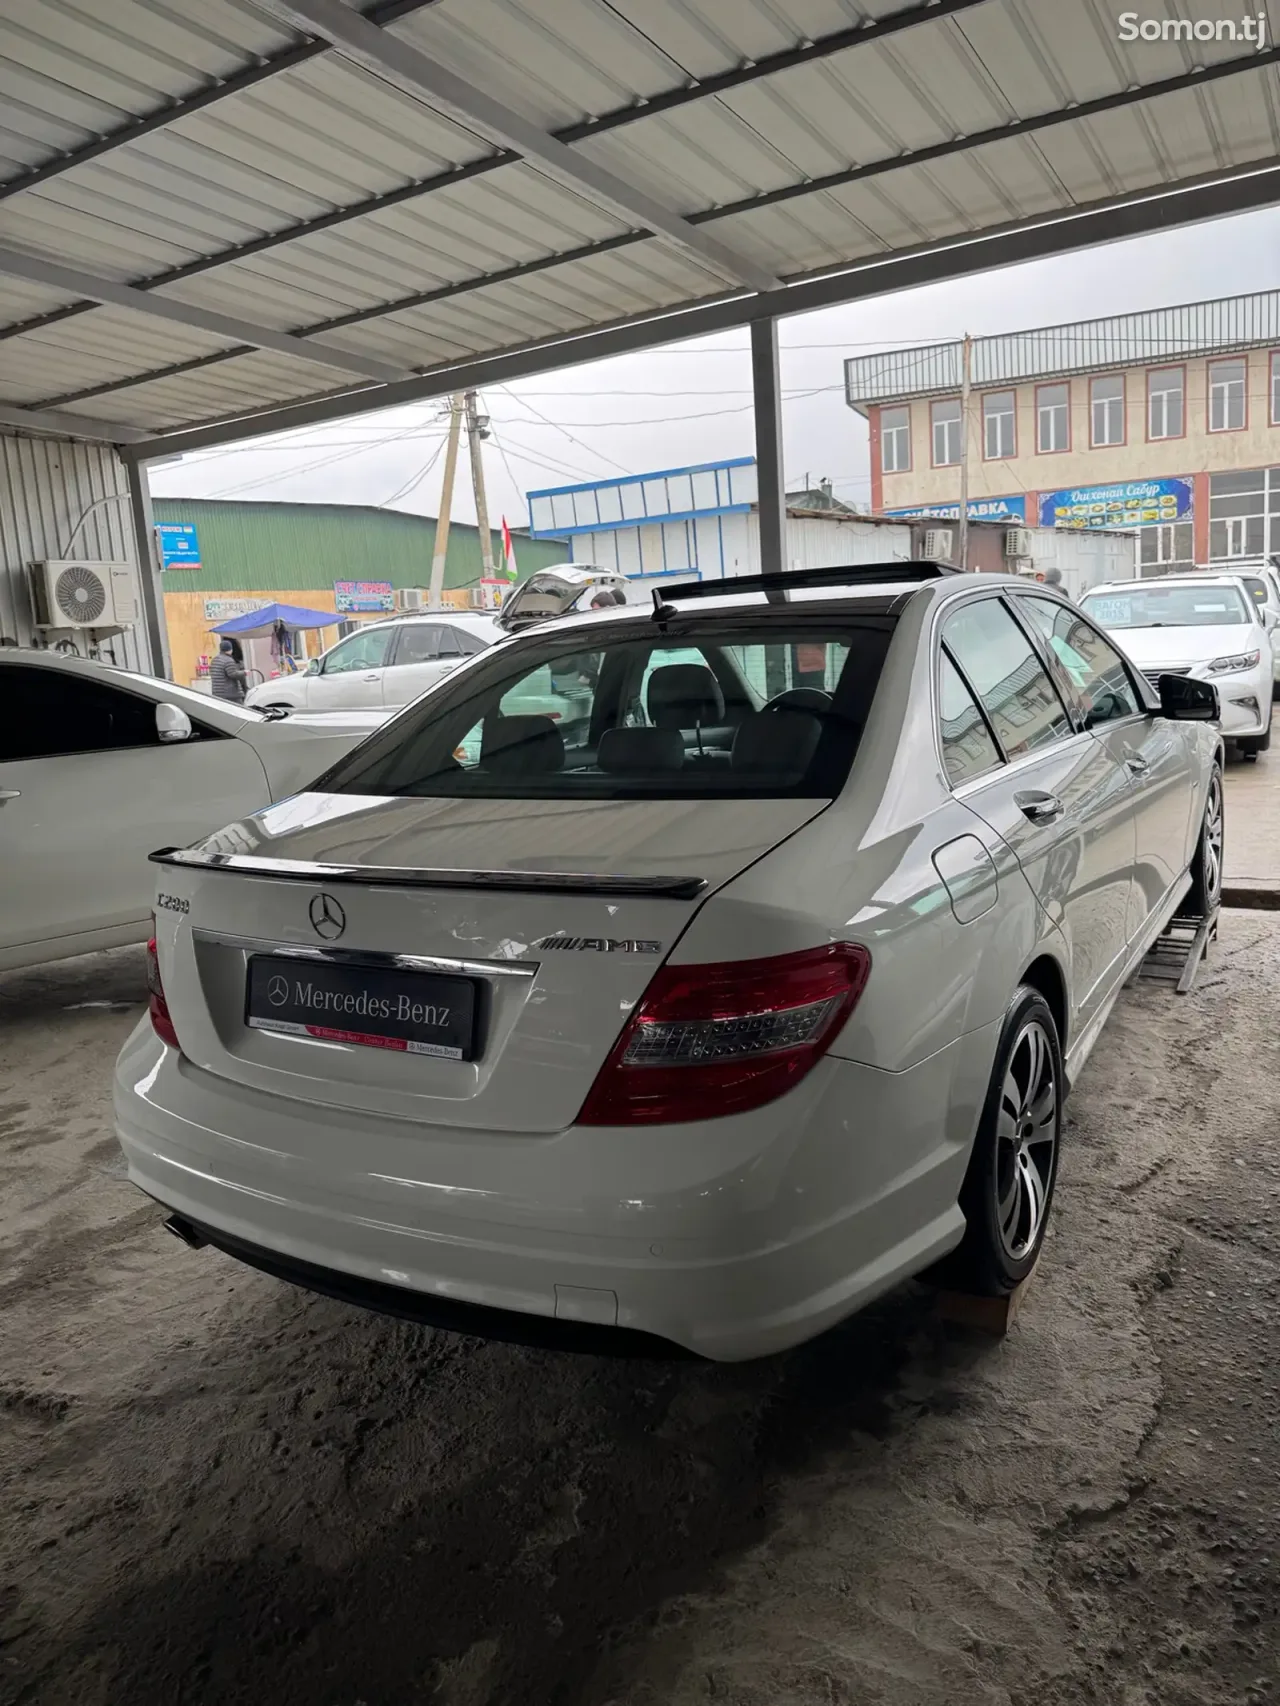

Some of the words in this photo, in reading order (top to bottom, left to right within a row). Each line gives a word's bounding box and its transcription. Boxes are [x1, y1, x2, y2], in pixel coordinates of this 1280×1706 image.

[1126, 484, 1160, 497] Сабур
[294, 981, 450, 1027] Mercedes-Benz
[416, 1043, 459, 1057] Mercedes-Benz
